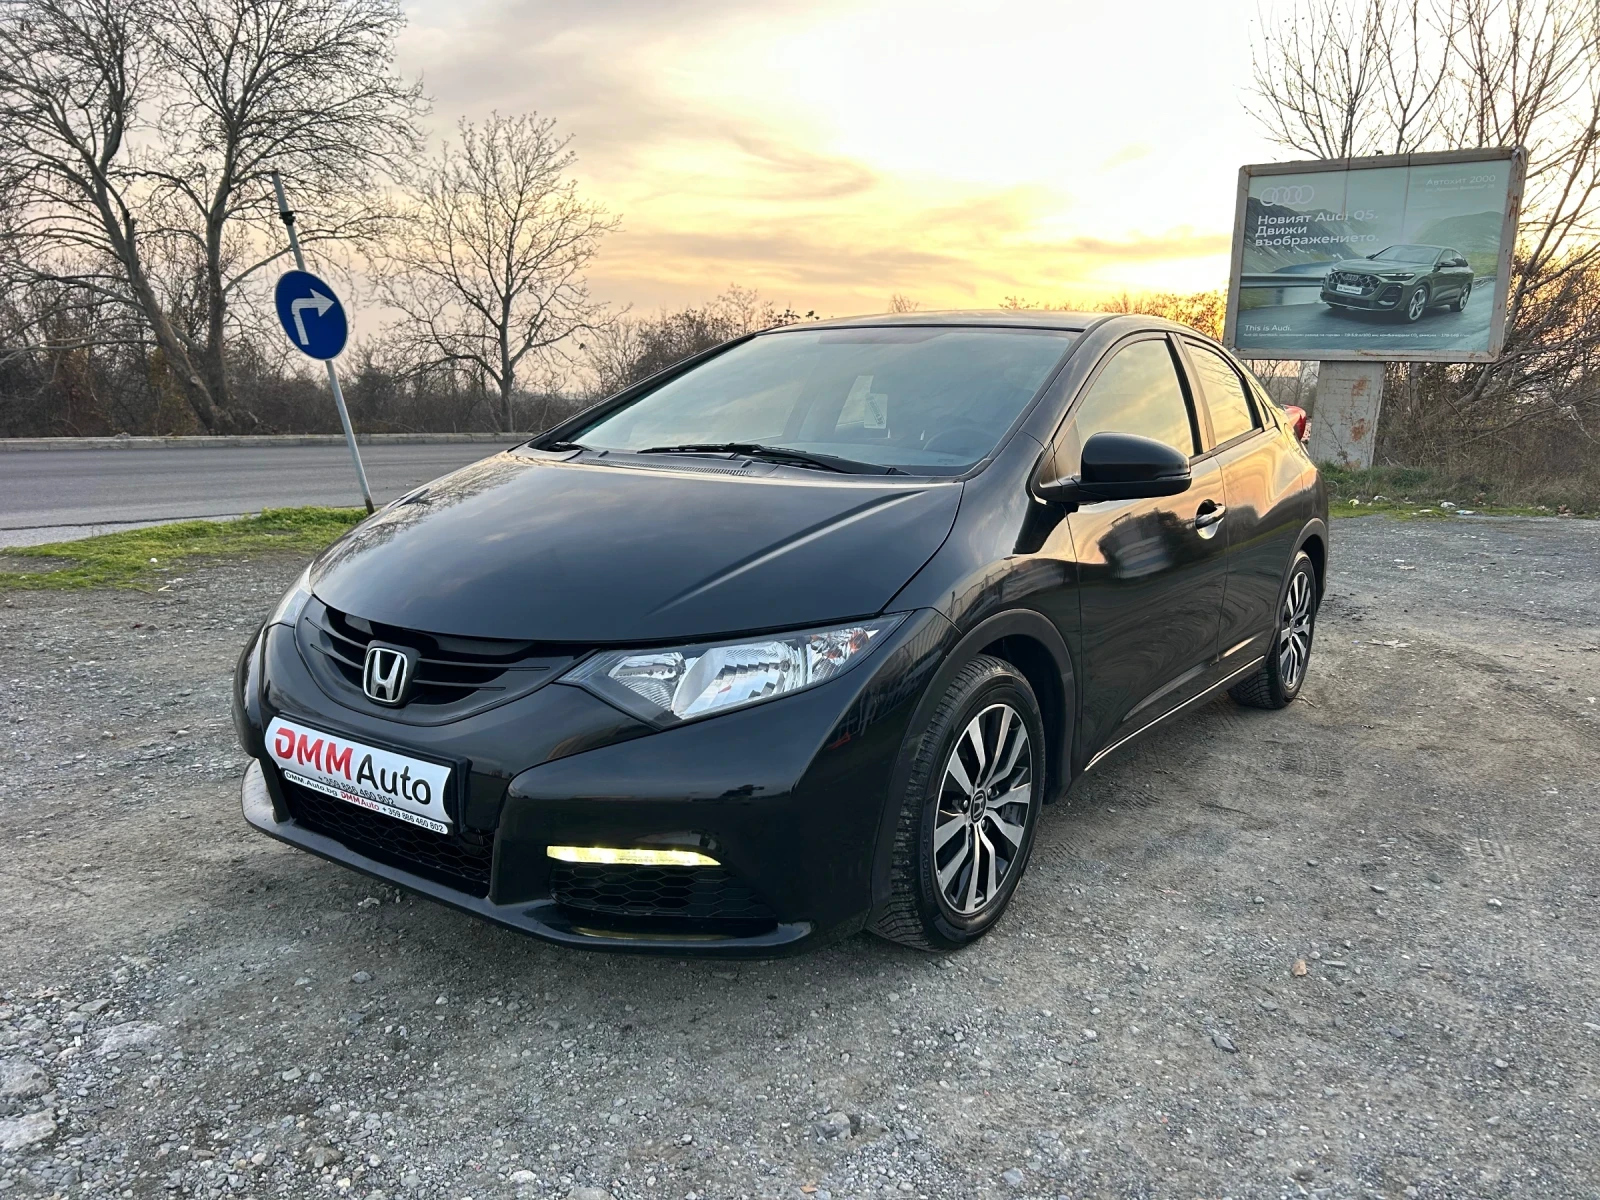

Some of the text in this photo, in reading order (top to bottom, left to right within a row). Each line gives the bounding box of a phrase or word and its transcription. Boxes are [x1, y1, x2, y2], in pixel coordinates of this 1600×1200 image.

[1426, 174, 1496, 186] Автохит 2000
[1257, 209, 1379, 225] Новият Audi Q5.
[1255, 226, 1308, 238] Движи
[1255, 234, 1380, 247] въображението.
[1244, 324, 1292, 332] This is Audi.
